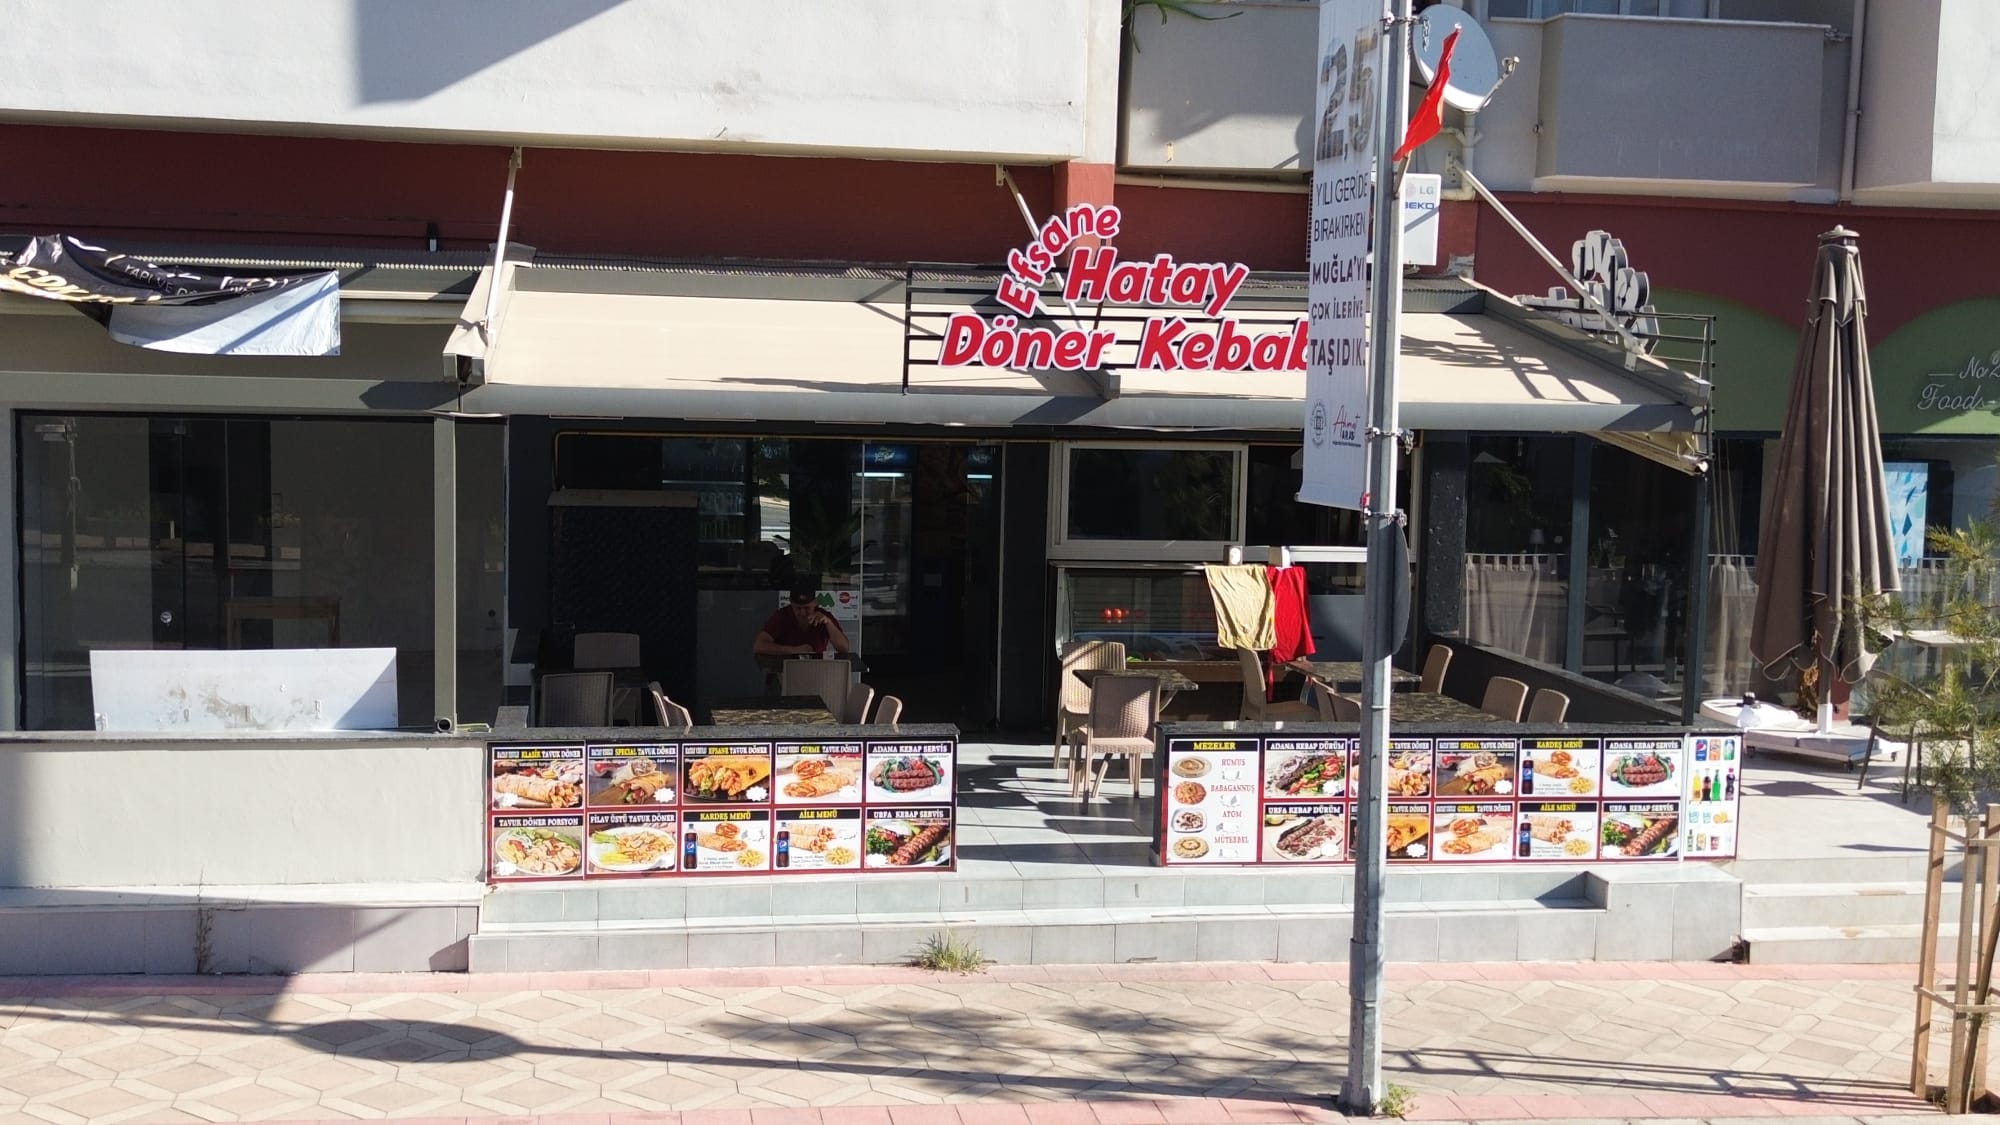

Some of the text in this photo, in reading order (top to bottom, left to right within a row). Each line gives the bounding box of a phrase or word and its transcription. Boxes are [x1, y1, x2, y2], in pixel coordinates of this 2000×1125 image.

[1316, 181, 1333, 206] YILI
[1419, 186, 1434, 195] LG
[998, 204, 1120, 317] Efsane
[1313, 253, 1365, 285] MUĞLA'YI
[1064, 247, 1249, 318] Hatay
[1311, 296, 1363, 326] ÇOK İLERİYE
[939, 313, 1309, 371] Döner Kebab
[872, 743, 948, 753] ADANA KEBAP SERVİS
[1193, 742, 1236, 751] MEZELER
[1270, 742, 1295, 750] ADANA
[1268, 806, 1288, 814] URFA
[1540, 802, 1556, 811] AİLE
[590, 815, 610, 824] PİLAV
[628, 815, 651, 823] TAVUK
[651, 813, 675, 822] DÖNER
[699, 810, 751, 821] KARDEŞ MENÜ
[799, 809, 838, 819] AİLE MENÜ
[1222, 810, 1243, 818] ATOM
[499, 819, 522, 827] TAVUK
[522, 817, 547, 826] DÖNER
